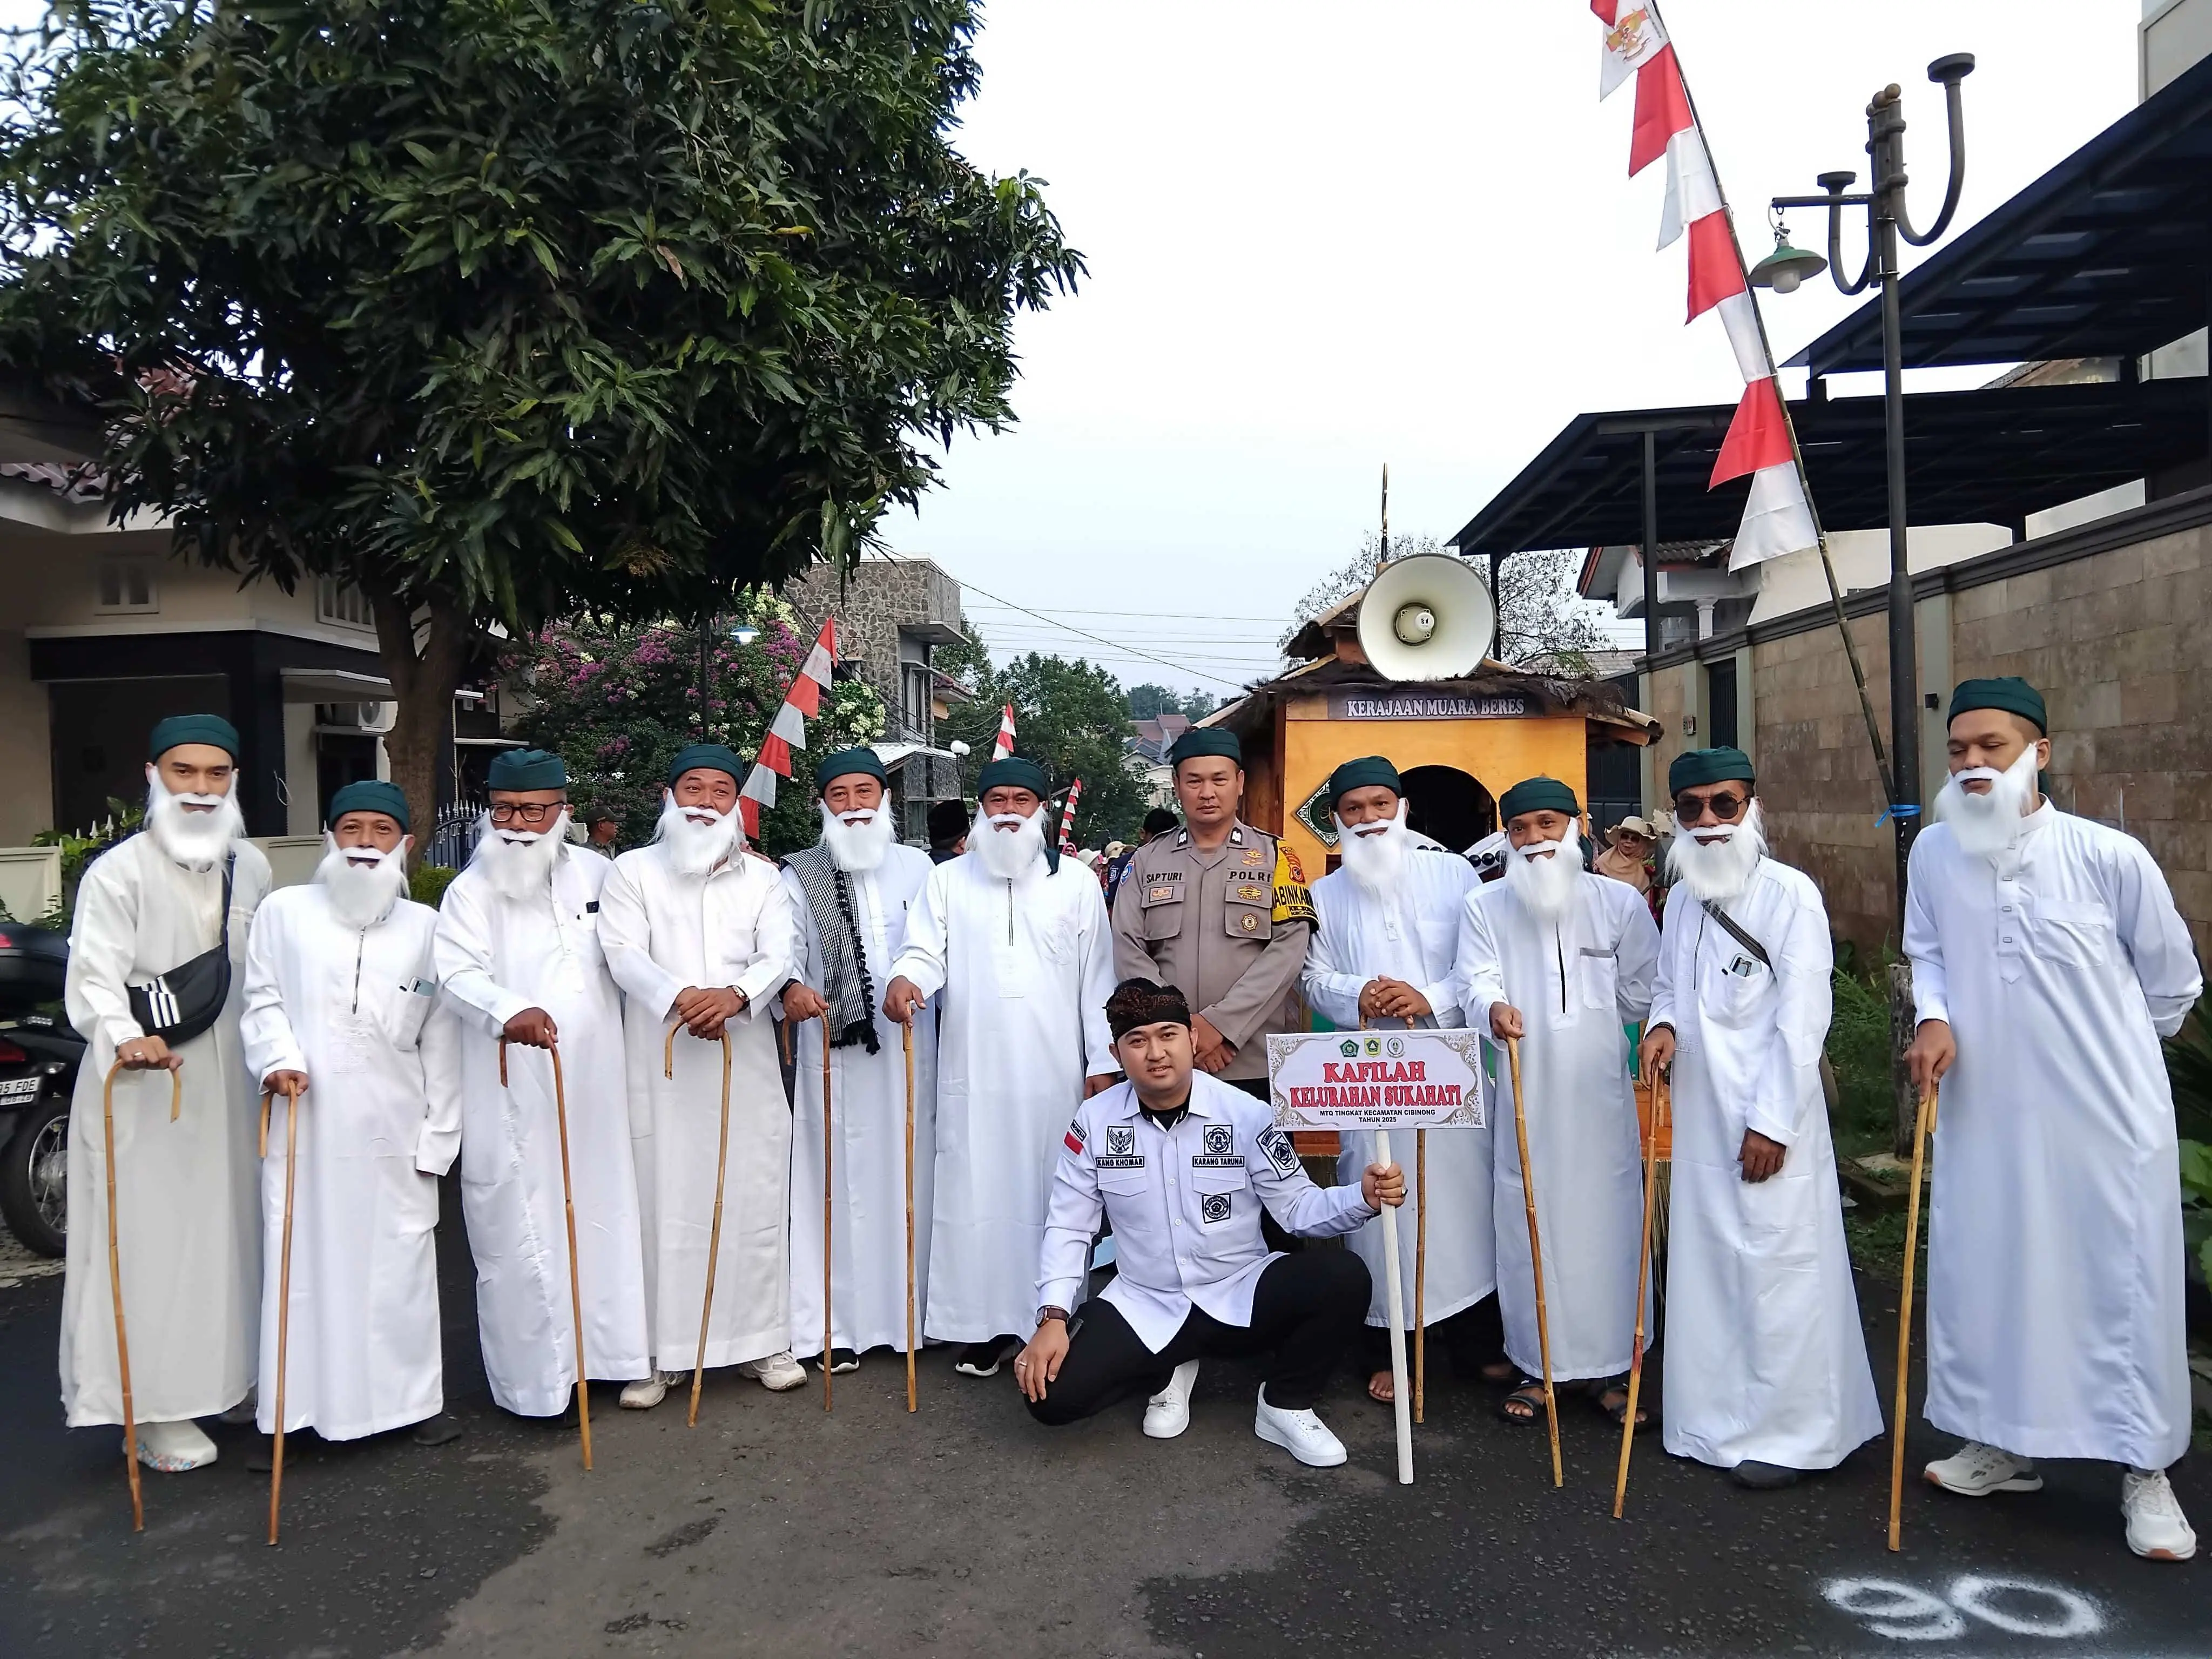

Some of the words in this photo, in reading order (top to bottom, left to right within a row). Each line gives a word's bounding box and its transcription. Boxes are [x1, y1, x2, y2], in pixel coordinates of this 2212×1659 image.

[1347, 700, 1424, 717] KERAJAAN
[1426, 699, 1479, 716] MUARA
[1480, 698, 1525, 715] BERES
[1146, 872, 1182, 884] SAPTURI
[1229, 871, 1271, 882] POLRI
[1323, 1061, 1426, 1083] KAFILAH
[16, 1080, 36, 1092] FDE
[1290, 1085, 1381, 1108] KELURAHAN
[1384, 1084, 1462, 1107] SUKAHATI
[1116, 1158, 1143, 1166] KHOMAR
[1220, 1157, 1243, 1165] TARUNA
